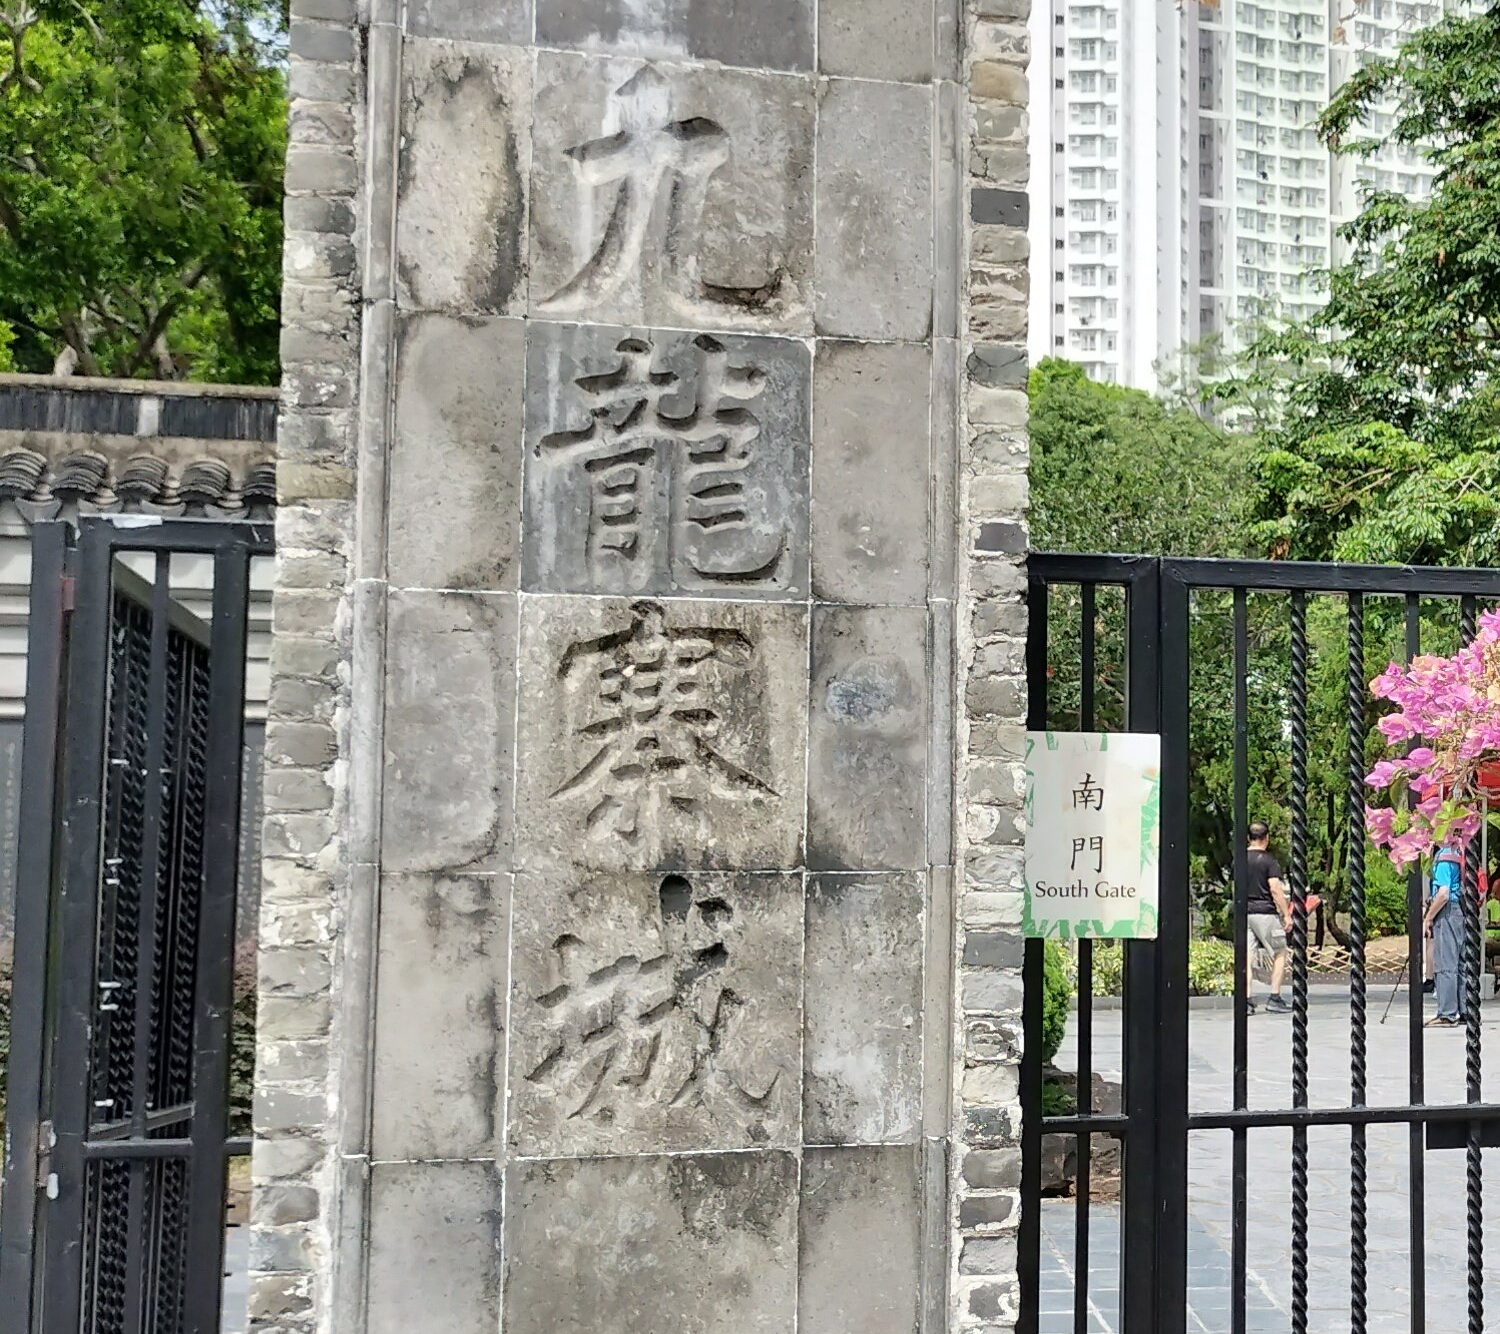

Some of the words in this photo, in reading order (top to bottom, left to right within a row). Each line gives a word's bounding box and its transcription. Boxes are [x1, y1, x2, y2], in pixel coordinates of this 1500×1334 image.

[1070, 772, 1105, 874] 南門
[1034, 878, 1089, 899] South
[1094, 879, 1137, 899] Gate
